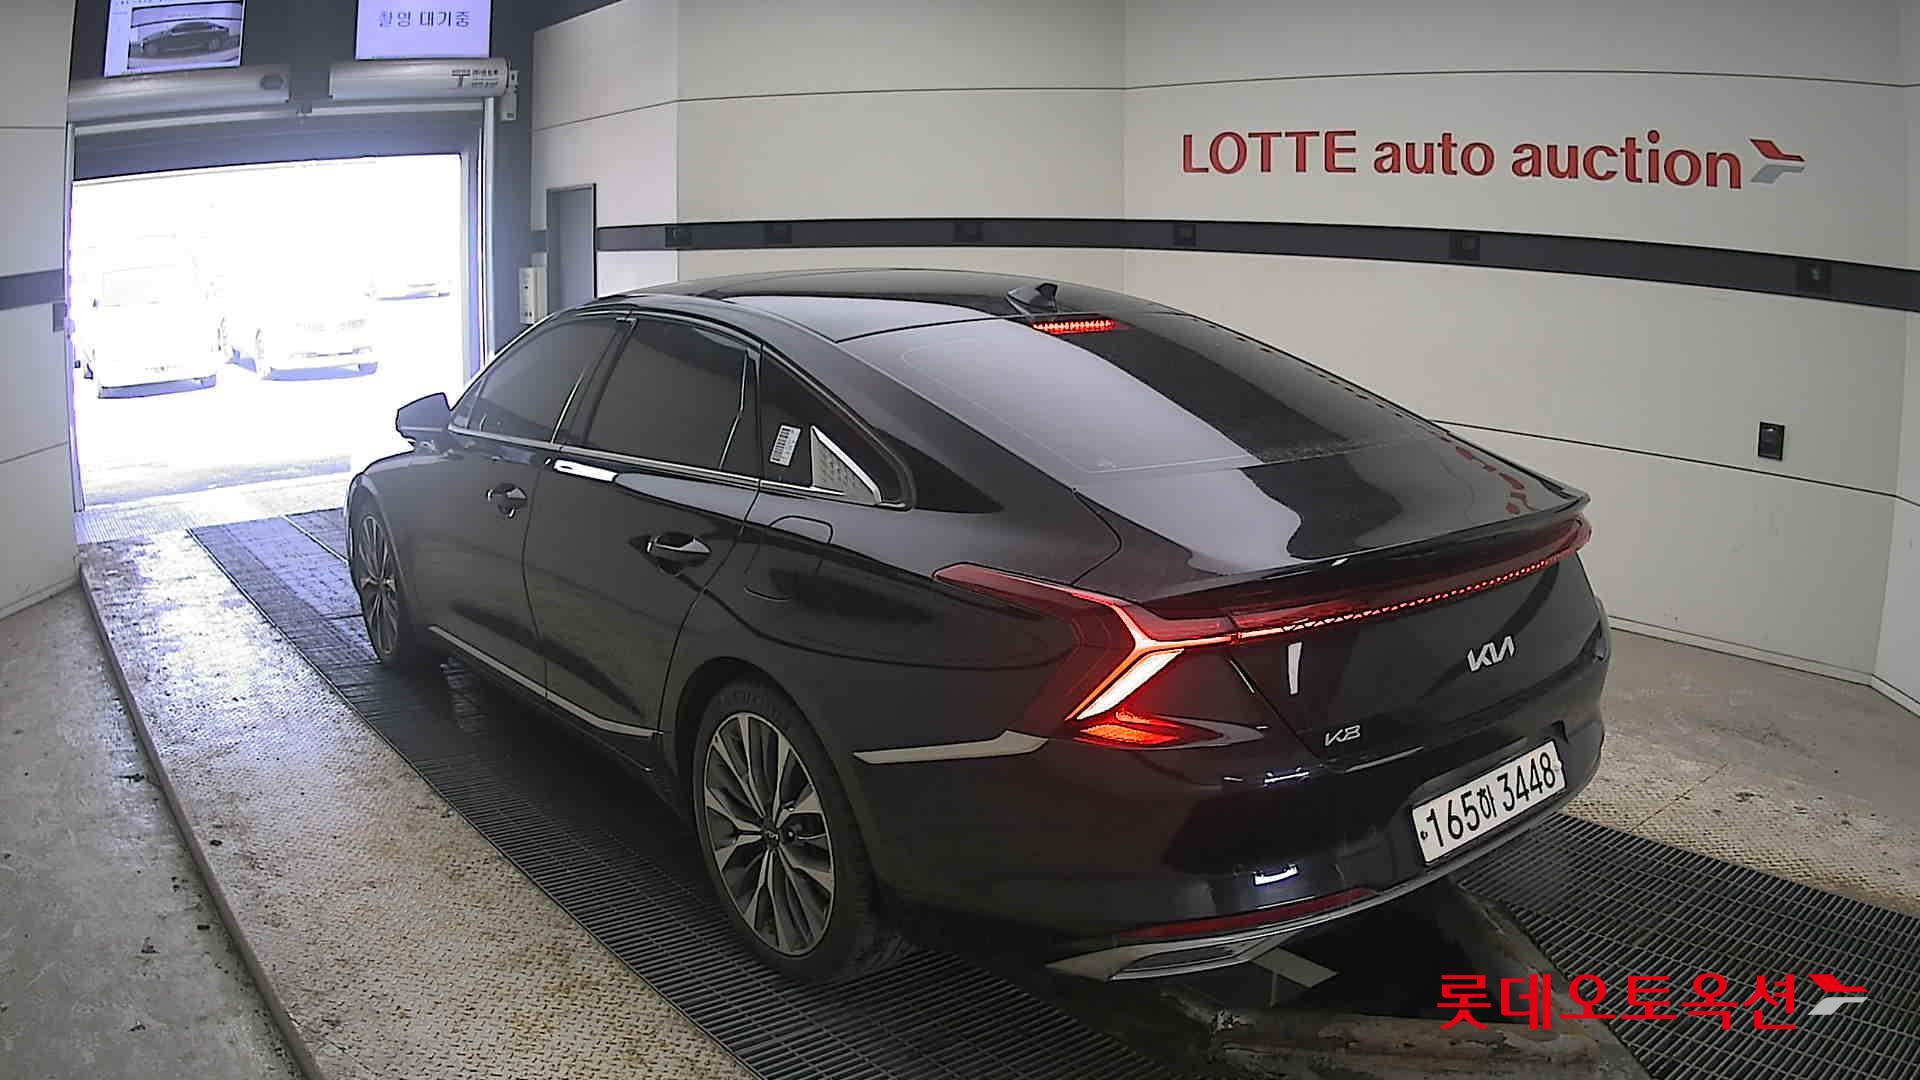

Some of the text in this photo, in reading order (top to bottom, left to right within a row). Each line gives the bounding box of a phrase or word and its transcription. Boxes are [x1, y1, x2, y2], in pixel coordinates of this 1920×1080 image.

[419, 10, 470, 28] 대기중
[1183, 130, 1741, 188] LOTTE auto auction
[1466, 635, 1516, 672] KIA
[1323, 724, 1361, 747] K8
[1426, 751, 1556, 848] 165하 3448
